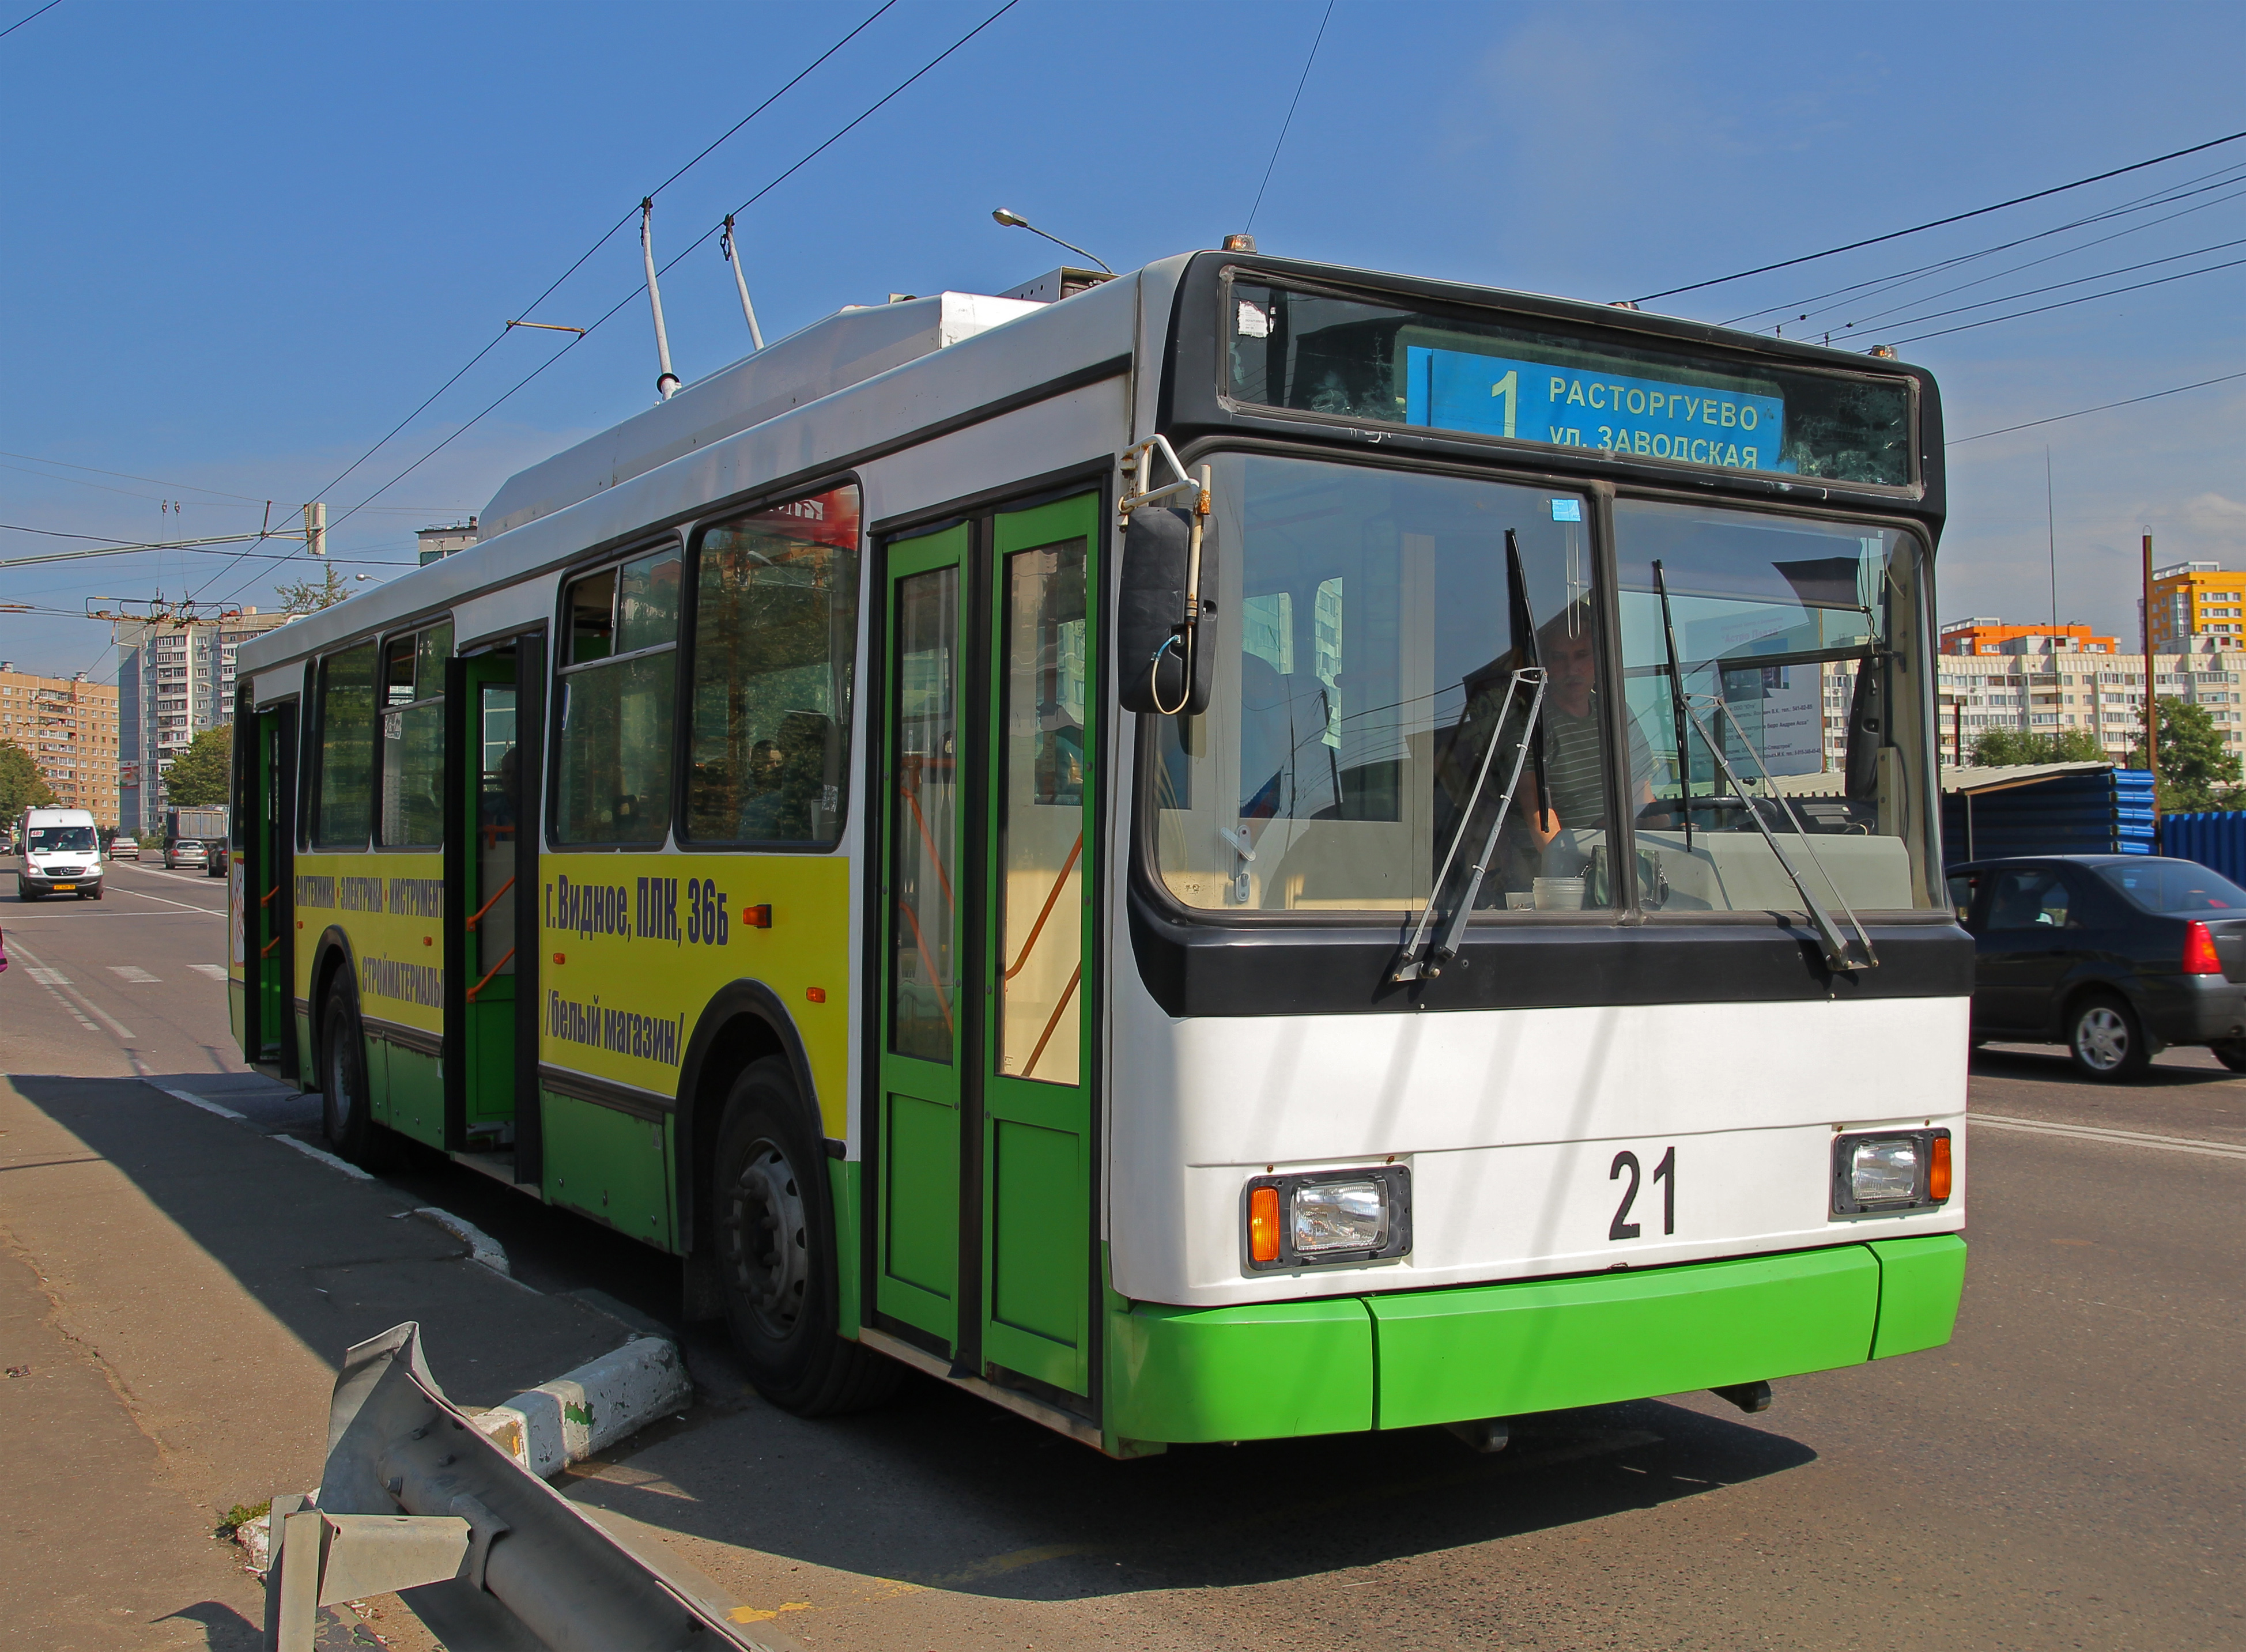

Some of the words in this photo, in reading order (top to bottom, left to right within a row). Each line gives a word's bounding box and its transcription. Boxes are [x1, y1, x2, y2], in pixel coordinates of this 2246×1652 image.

[1491, 370, 1518, 438] 1
[1549, 377, 1759, 432] РАСТОРГУЕВО
[1597, 425, 1758, 470] ЗАВОДСКАЯ
[296, 875, 335, 909] САНТЕХНИКА
[341, 876, 383, 913] ЭЛЕКТРИКА
[636, 876, 682, 948] ПЛК,
[545, 988, 601, 1048] /белый
[604, 1008, 685, 1067] магазин/
[1609, 1146, 1675, 1241] 21
